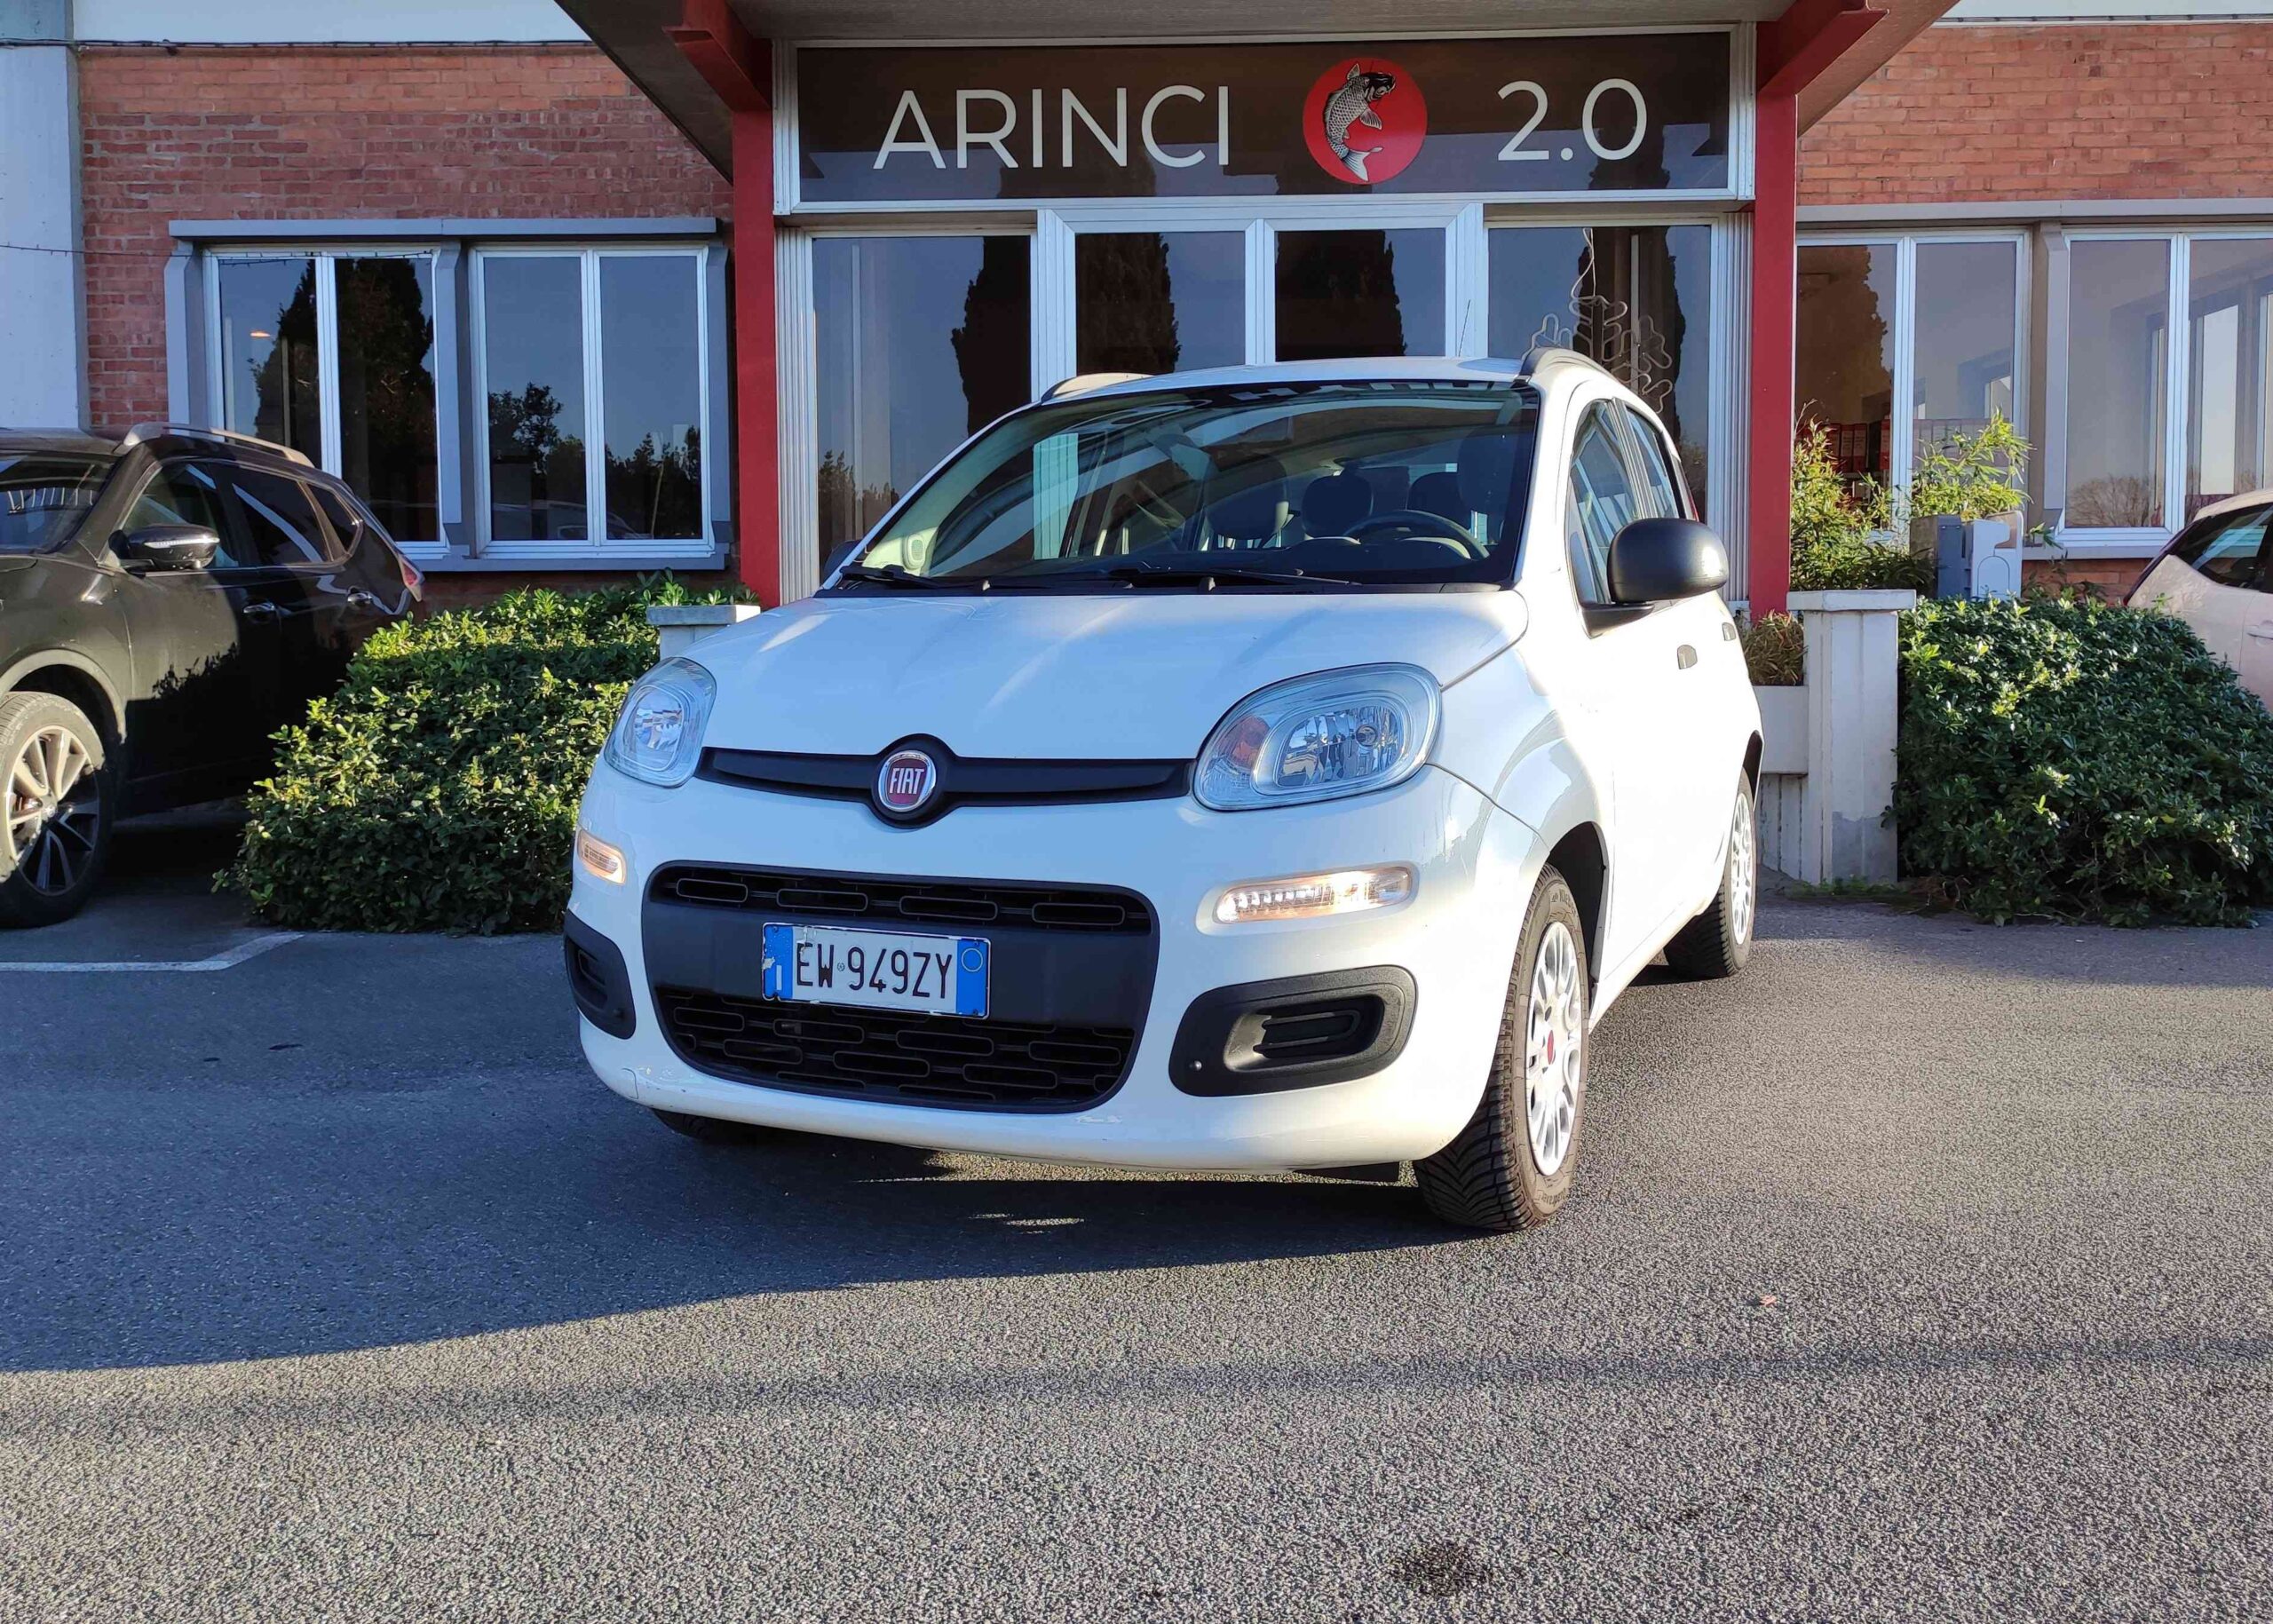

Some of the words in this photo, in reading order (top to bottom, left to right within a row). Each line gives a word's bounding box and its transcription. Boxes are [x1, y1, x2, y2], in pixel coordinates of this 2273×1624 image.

[873, 86, 1230, 170] ARINCI
[1497, 78, 1648, 161] 2.0
[889, 767, 924, 794] FIAT
[796, 942, 835, 987] EW
[847, 946, 953, 999] 949ZY
